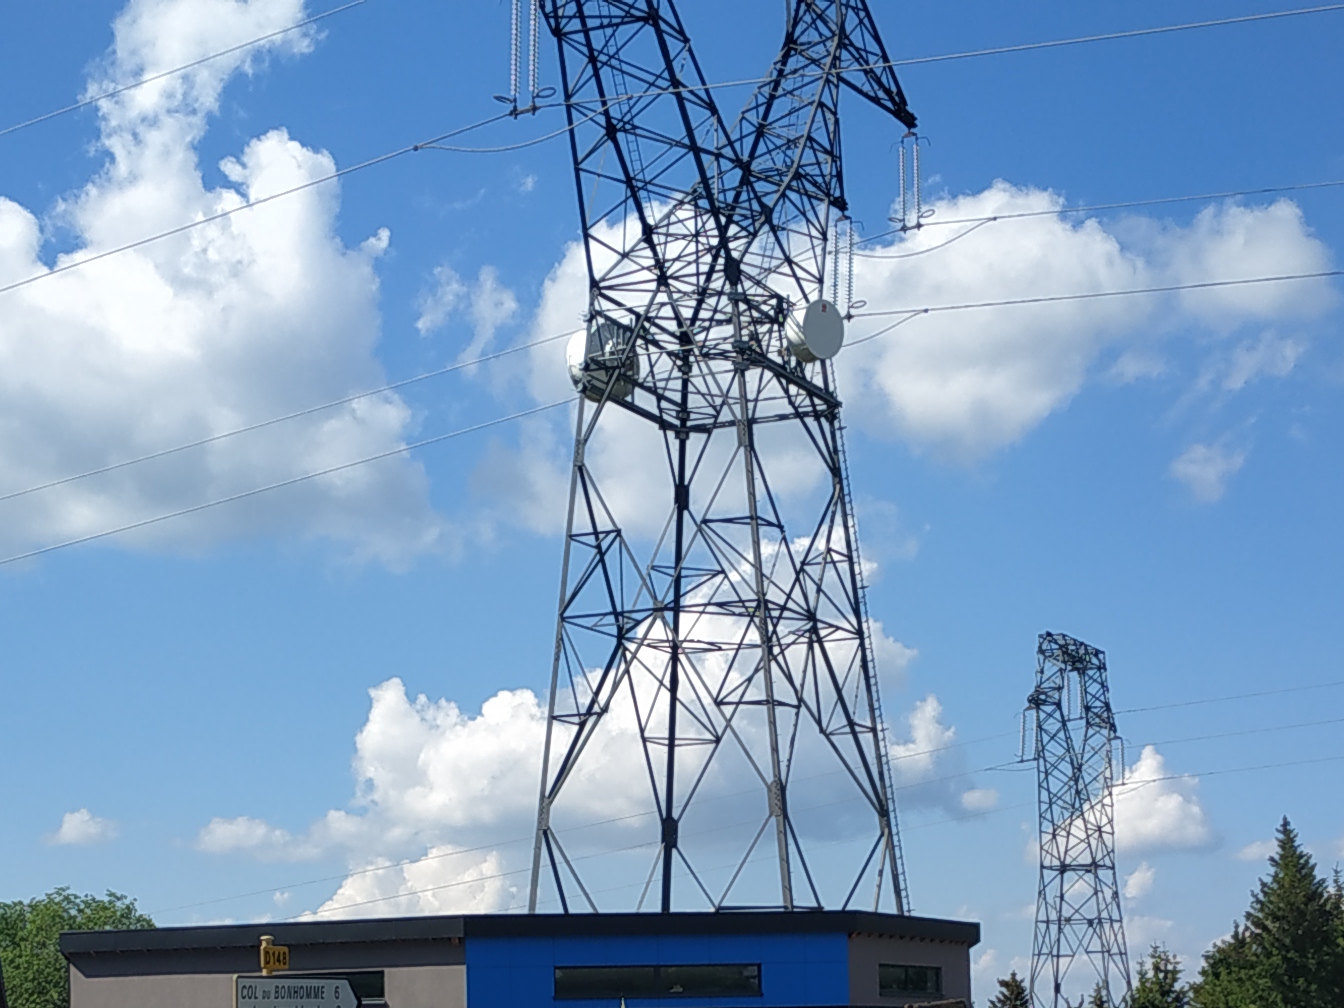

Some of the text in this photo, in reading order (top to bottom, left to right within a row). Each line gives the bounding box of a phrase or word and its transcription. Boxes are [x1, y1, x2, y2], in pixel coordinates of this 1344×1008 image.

[241, 985, 340, 1000] COL DU BONHOMME 6
